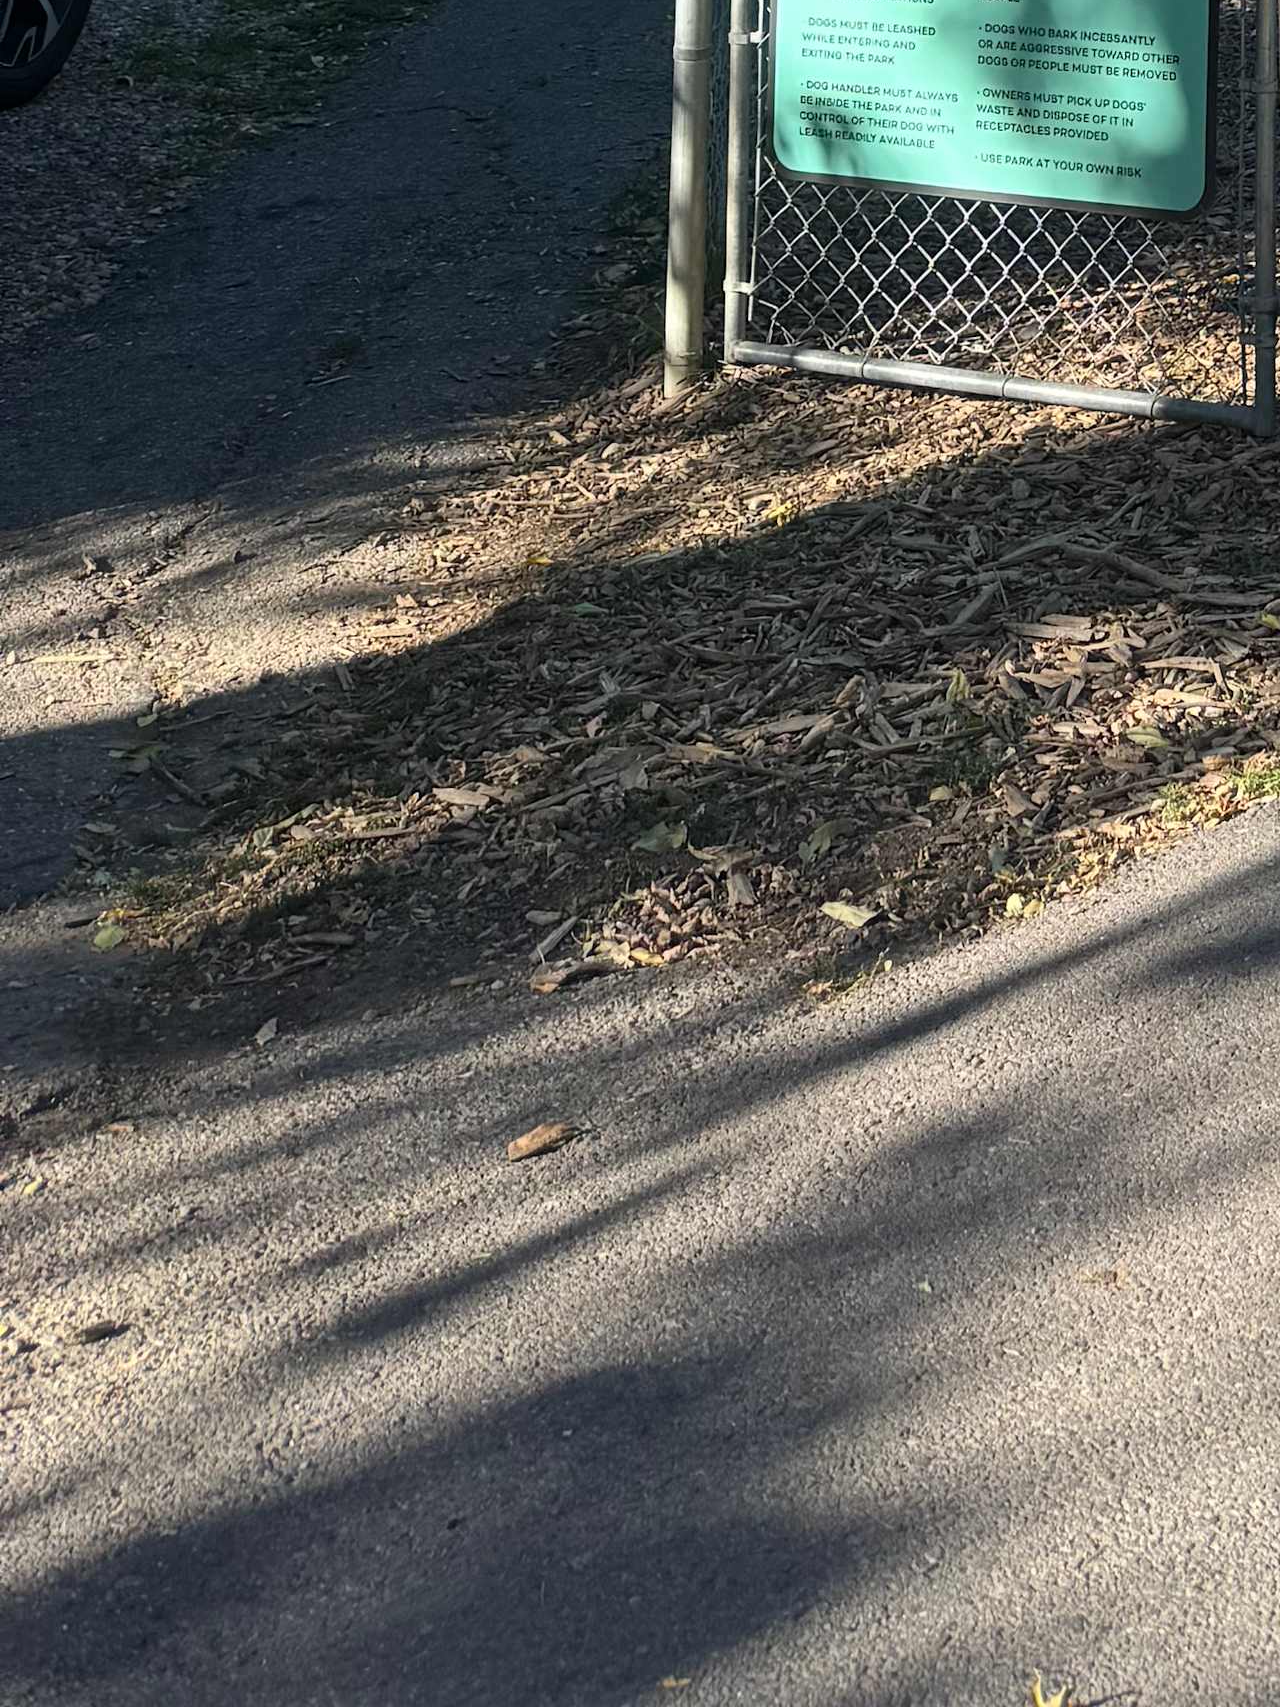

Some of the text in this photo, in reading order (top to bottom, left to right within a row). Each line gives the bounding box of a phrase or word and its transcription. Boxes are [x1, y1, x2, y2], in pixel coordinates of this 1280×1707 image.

[809, 17, 936, 35] DOGS MUST BE LEASHED
[985, 23, 1155, 46] DOGS WHO BARK INCESSANTLY
[802, 33, 915, 50] WHILE ENTERING AND
[802, 48, 895, 64] EXITING THE PARK
[978, 40, 1180, 65] OR ARE AGGRESSIVE TOWARD OTHER
[978, 55, 1176, 81] DOGS OR PEOPLE MUST BE REMOVED
[807, 81, 958, 102] DOG HANDLER MUST ALWAYS
[983, 88, 1031, 101] OWNERS
[1034, 93, 1064, 103] MUST
[1067, 95, 1091, 107] PICK
[1095, 98, 1109, 108] UP
[801, 96, 941, 117] BE INSIDE THE PARK AND IN
[977, 104, 1133, 127] WASTE AND DISPOSE OF IT IN
[800, 111, 954, 134] CONTROL OF THEIR DOG WITH
[976, 120, 1109, 141] RECEPTACLES PROVIDED
[800, 127, 935, 148] LEASH READILY AVAILABLE
[981, 152, 1142, 178] USE PARK AT YOUR OWN RISK
